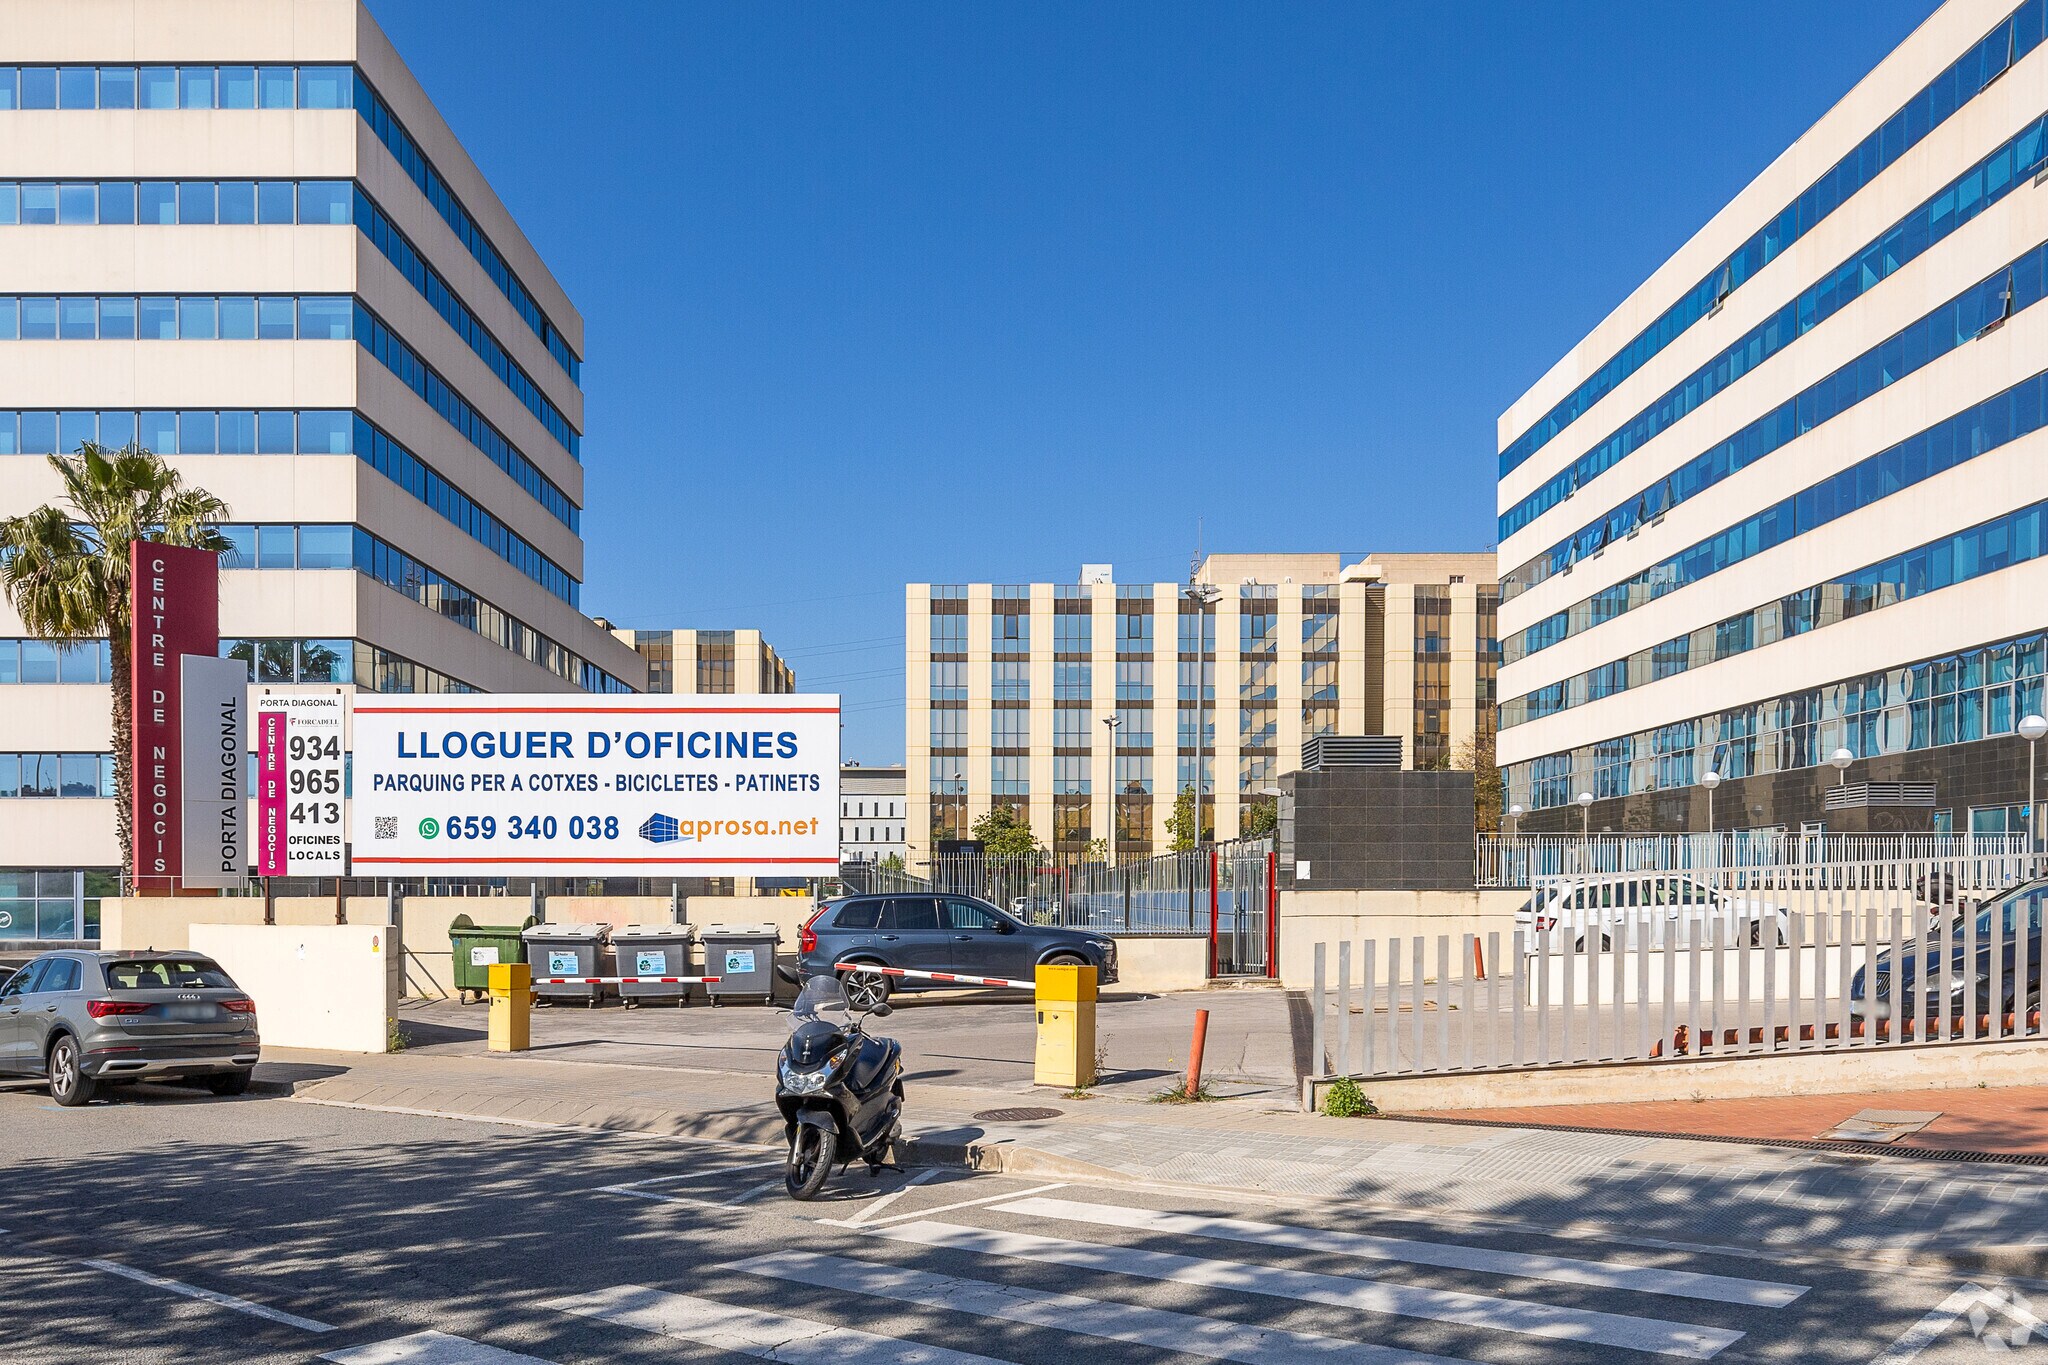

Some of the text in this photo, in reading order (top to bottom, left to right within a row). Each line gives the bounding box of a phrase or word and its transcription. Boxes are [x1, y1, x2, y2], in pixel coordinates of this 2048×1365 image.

[152, 558, 167, 872] CENTRE DE NEGOCIS
[260, 699, 338, 707] PORTA DIAGONAL
[290, 736, 340, 760] 934
[398, 731, 574, 759] LLOGUER
[220, 696, 237, 873] PORTA DIAGONAL
[267, 718, 276, 869] CENTRE DE NEGOCIS
[290, 769, 340, 794] 965
[374, 774, 465, 792] PARQUING
[471, 774, 505, 791] PER
[511, 774, 523, 791] A
[529, 774, 598, 792] COTXES
[616, 774, 718, 792] BICICLETES
[736, 774, 820, 792] PATINETS
[290, 803, 340, 824] 413
[446, 815, 619, 839] 659 340 038
[680, 817, 818, 842] aprosa.net
[289, 836, 340, 844] OFICINES
[289, 851, 340, 860] LOCALS
